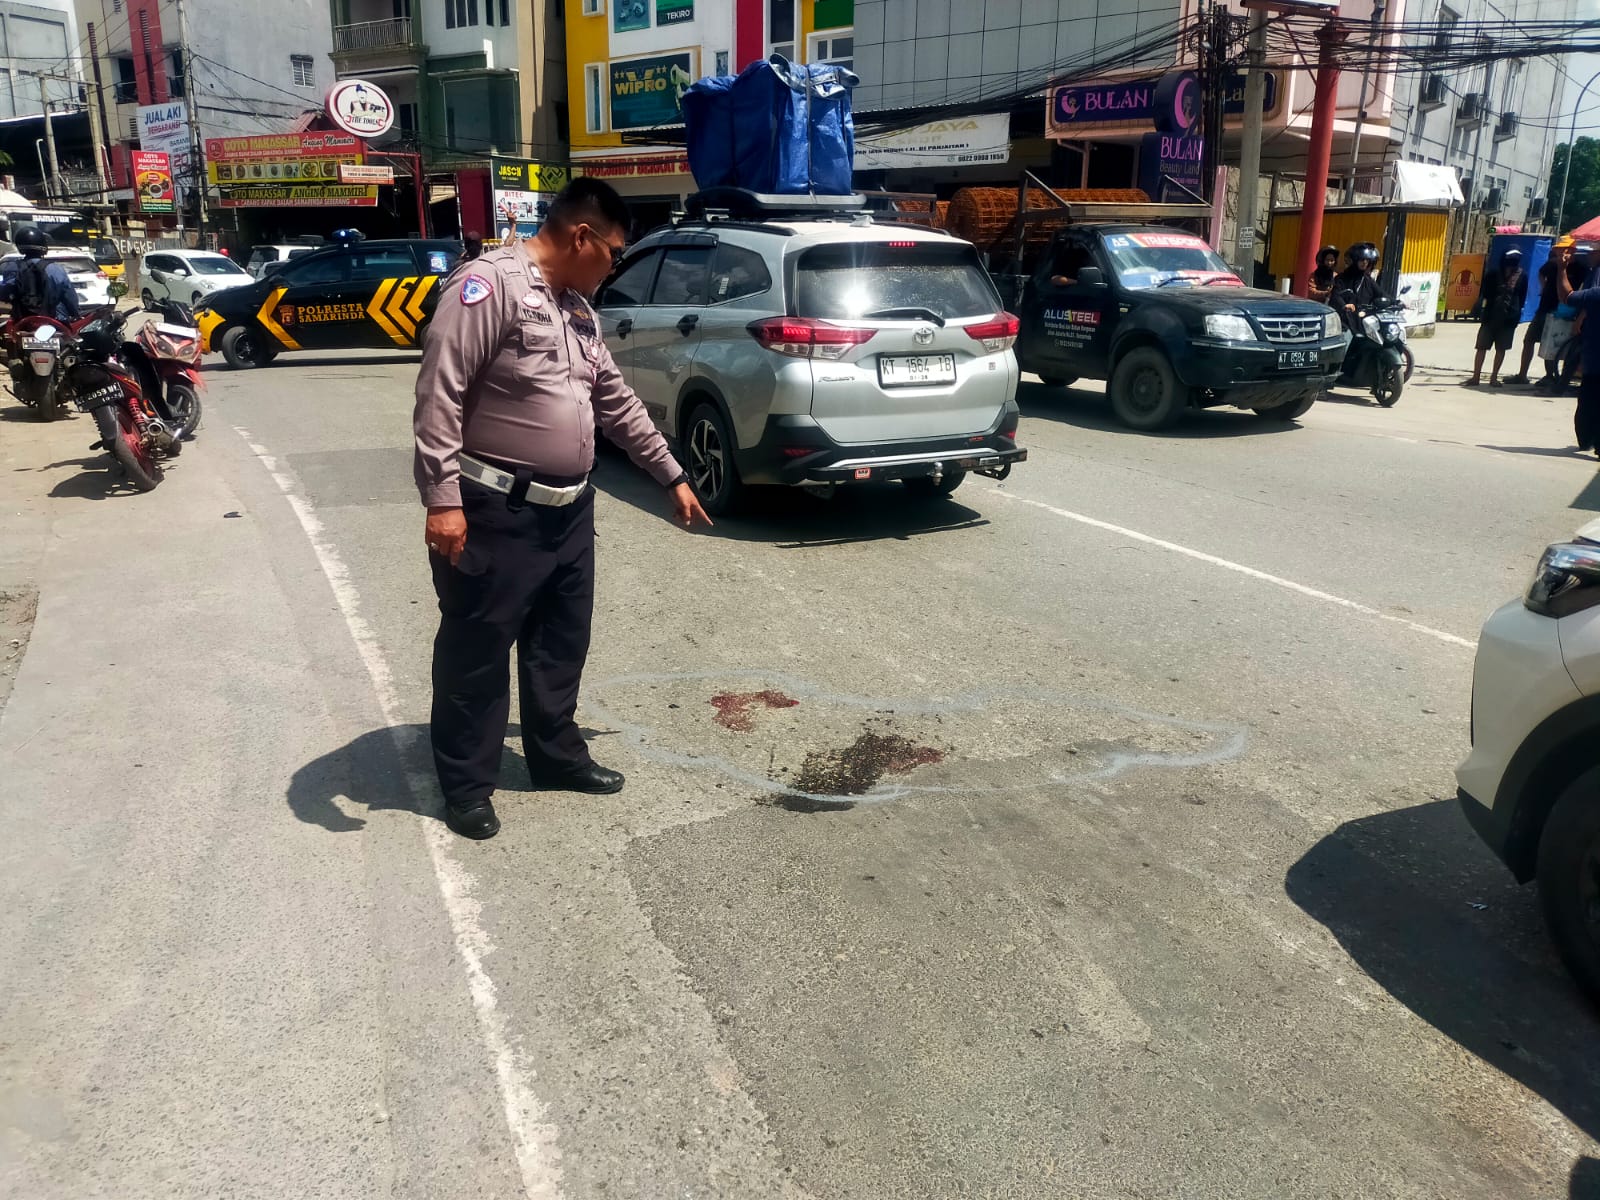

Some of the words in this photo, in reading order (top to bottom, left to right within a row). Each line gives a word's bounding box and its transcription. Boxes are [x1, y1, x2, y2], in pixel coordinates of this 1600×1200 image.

[666, 10, 691, 21] TEKIRO
[615, 78, 667, 96] WIPRO
[1085, 89, 1148, 111] BULAN
[144, 110, 165, 125] JUAL
[167, 105, 181, 120] AKI
[224, 140, 248, 151] COTO
[249, 135, 300, 149] MAKASSAR
[1160, 136, 1203, 161] BULAN
[498, 165, 523, 177] JASON
[1159, 160, 1182, 177] Beauty
[1184, 161, 1201, 175] Land
[248, 189, 287, 199] MAKASSAR
[293, 186, 325, 198] ANGING
[327, 185, 368, 197] MAMMIRI
[1112, 237, 1130, 247] AS
[1142, 236, 1204, 248] TRANSPORT
[297, 303, 365, 315] POLRESTA
[1043, 309, 1098, 323] ALUSTEEL
[299, 311, 366, 323] SAMARINDA
[882, 359, 895, 375] KT
[906, 357, 930, 373] 1564
[940, 357, 952, 371] IB
